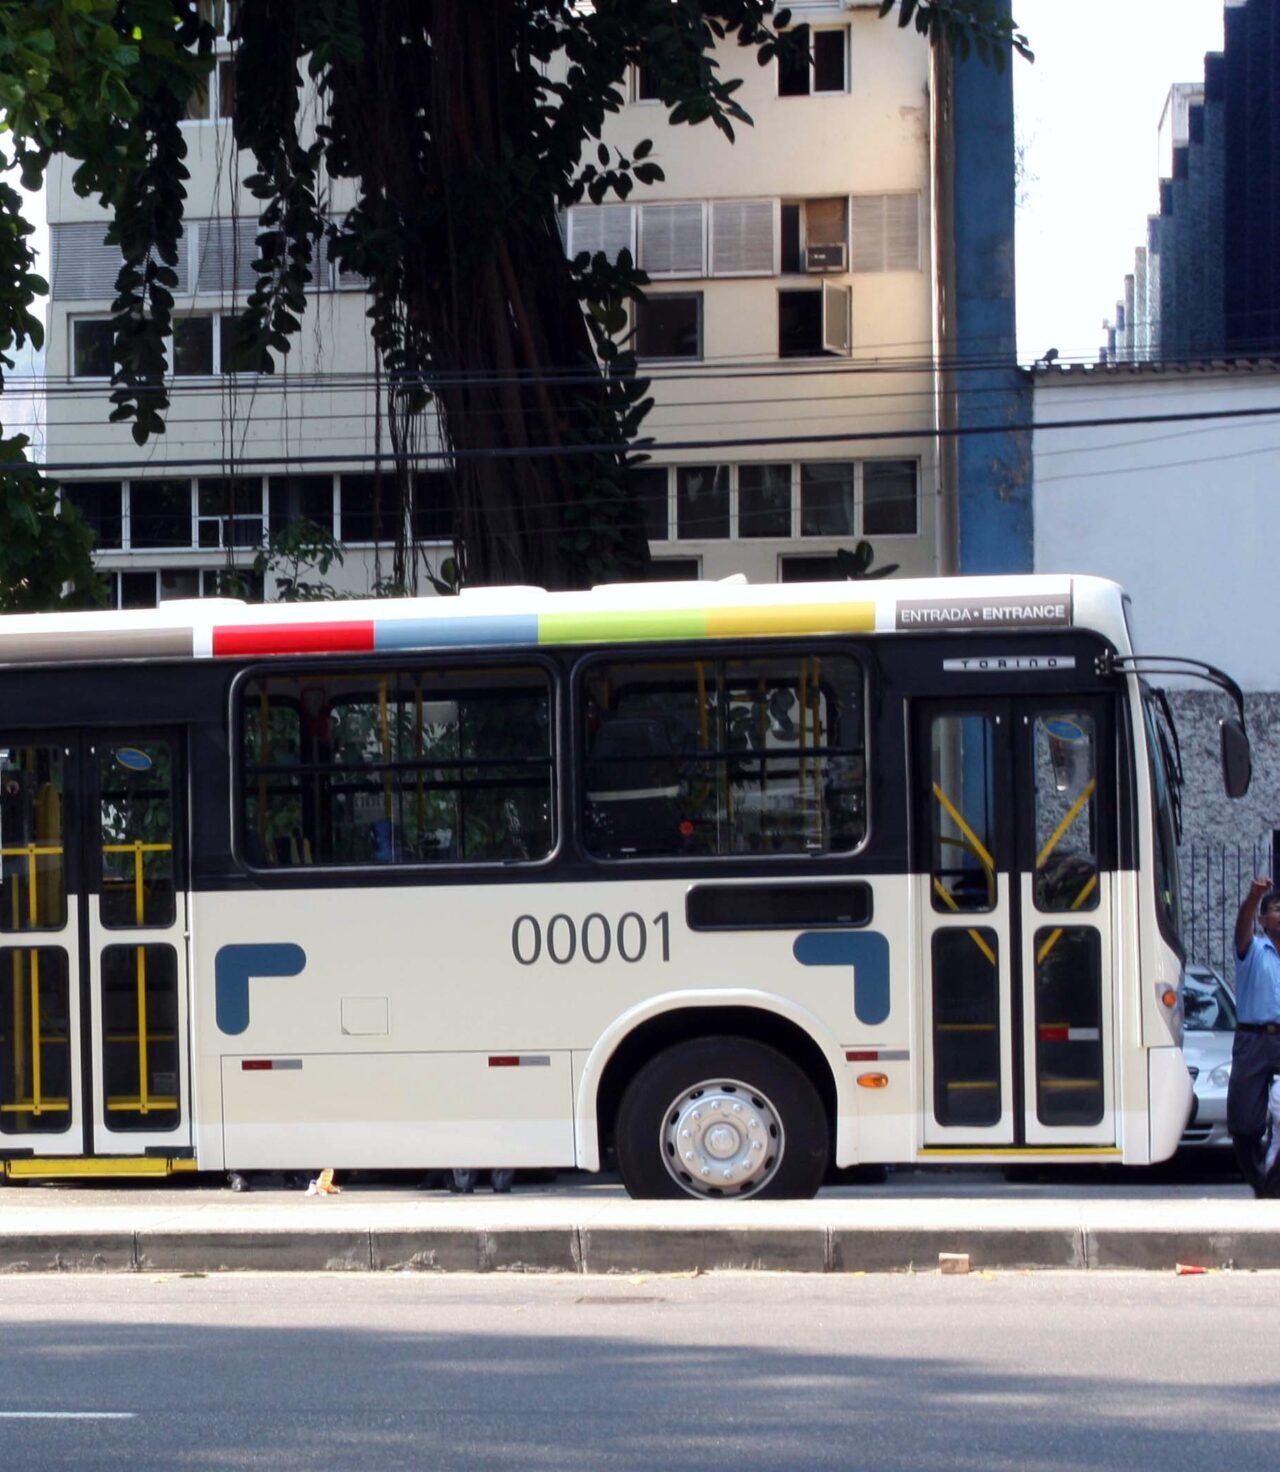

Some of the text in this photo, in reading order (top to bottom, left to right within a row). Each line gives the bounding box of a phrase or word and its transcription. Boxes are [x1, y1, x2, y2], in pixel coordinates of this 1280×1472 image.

[901, 605, 1065, 623] ENTRADA ENTRANCE
[961, 658, 1058, 669] TORINO
[511, 910, 670, 965] 00001
